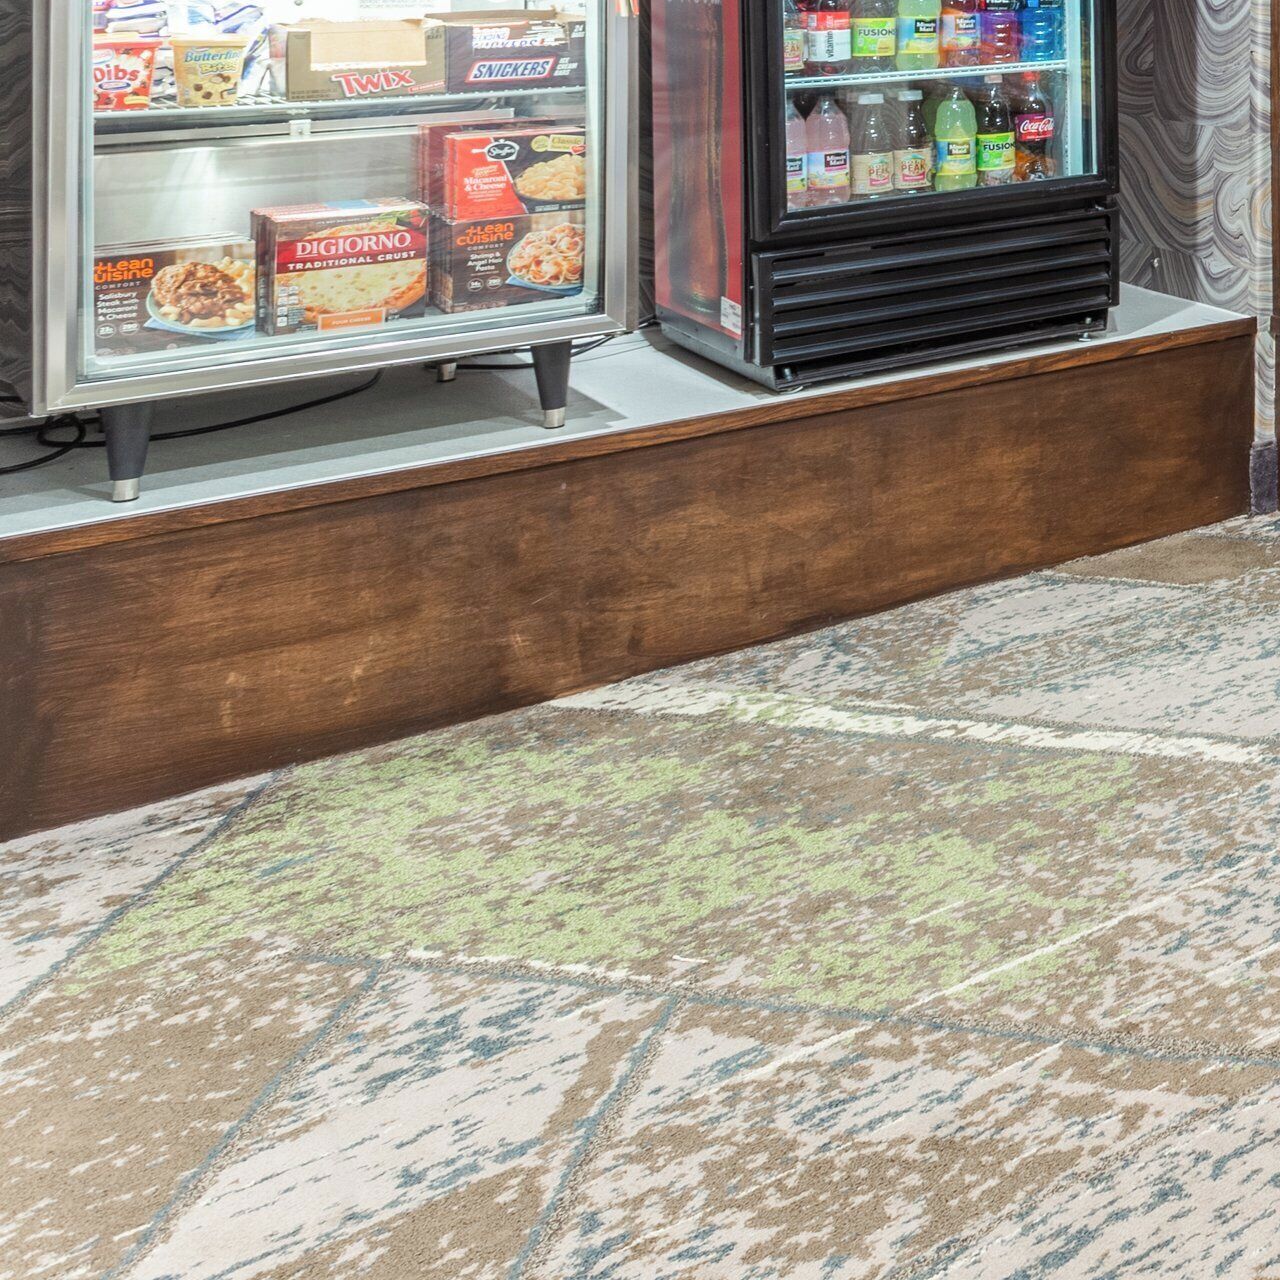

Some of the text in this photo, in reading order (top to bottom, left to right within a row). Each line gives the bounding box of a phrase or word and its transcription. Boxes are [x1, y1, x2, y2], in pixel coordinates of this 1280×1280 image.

[94, 65, 140, 82] Dibs
[473, 61, 550, 78] SNICKERS
[464, 176, 507, 184] Macaroni
[288, 251, 416, 270] TRADITIONAL CRUST
[96, 281, 140, 290] COMFORT
[99, 291, 137, 301] Salisbury
[98, 305, 138, 314] Macaroni
